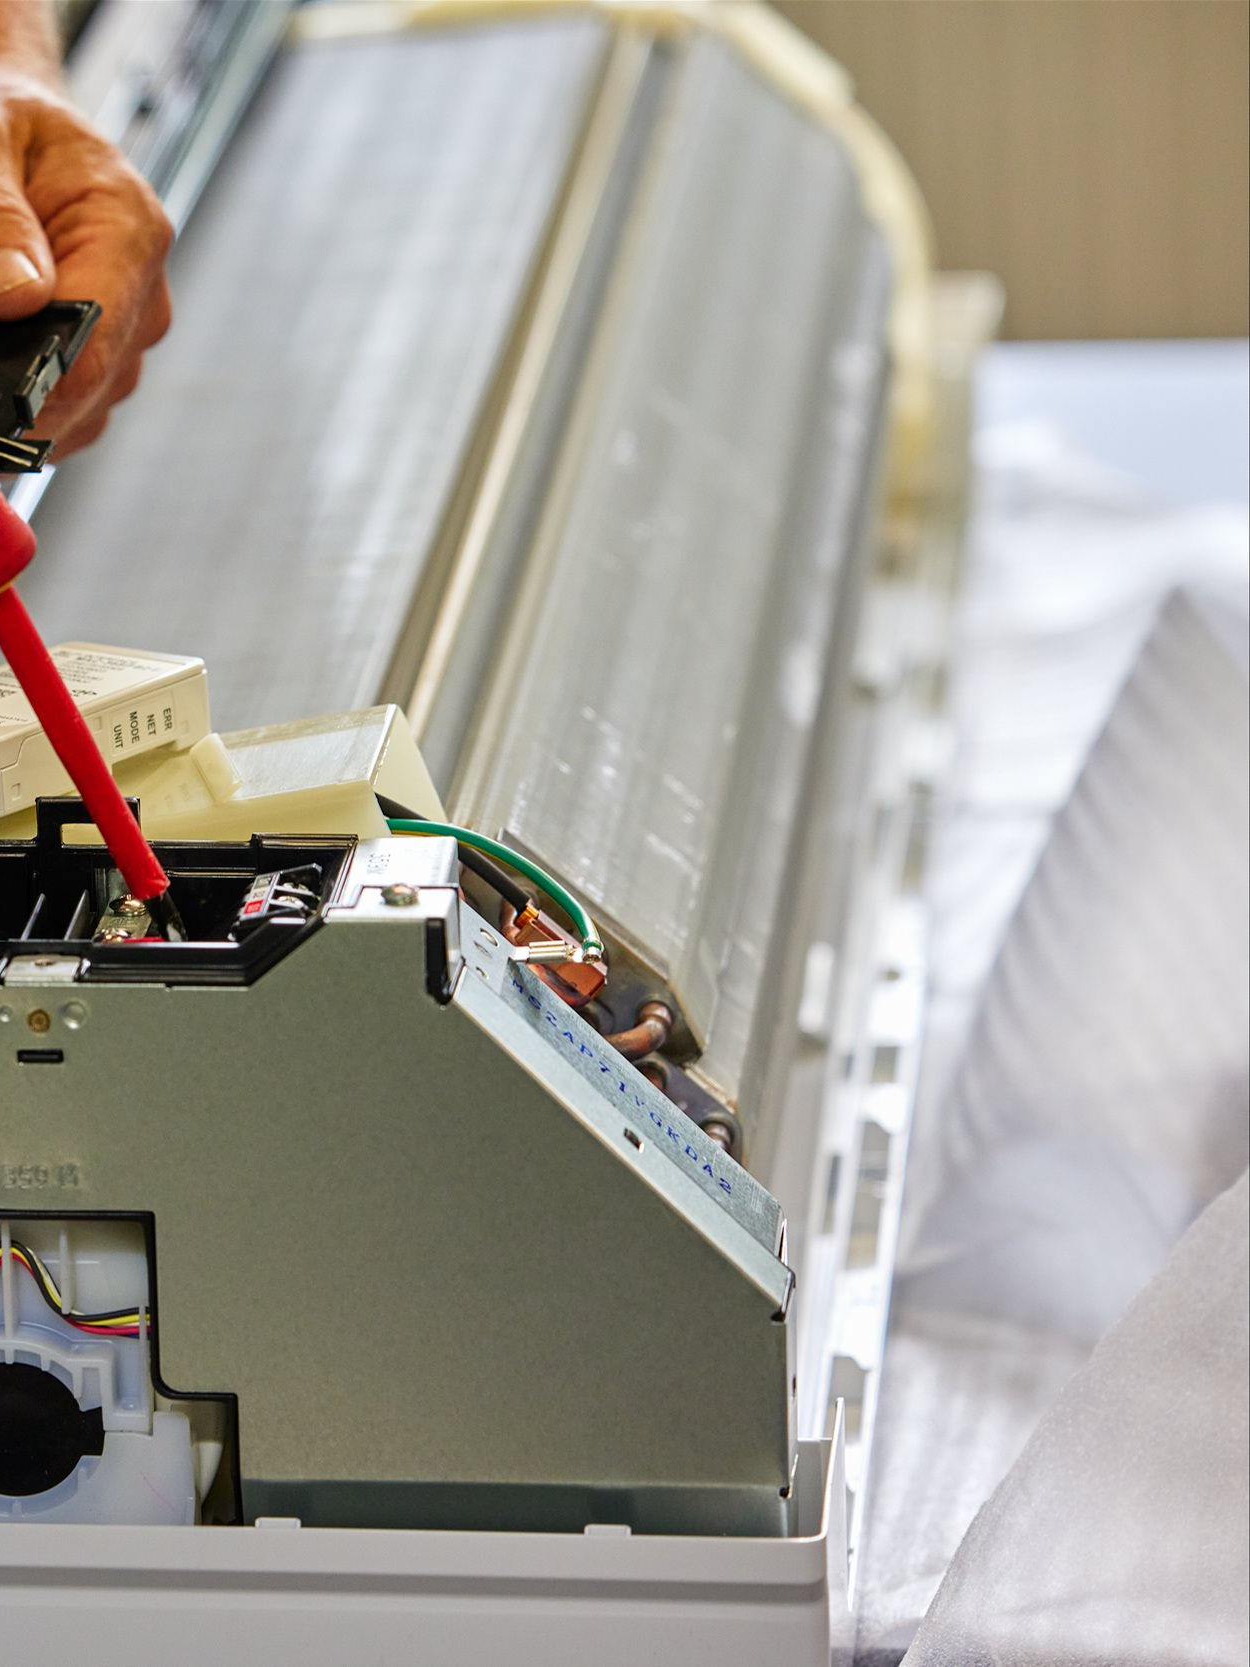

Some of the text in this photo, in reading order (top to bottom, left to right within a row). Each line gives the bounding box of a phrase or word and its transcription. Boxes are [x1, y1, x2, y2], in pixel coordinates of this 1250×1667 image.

[130, 711, 140, 744] MODE
[147, 714, 156, 736] NET
[163, 707, 172, 730] ERR
[113, 724, 123, 748] UNIT
